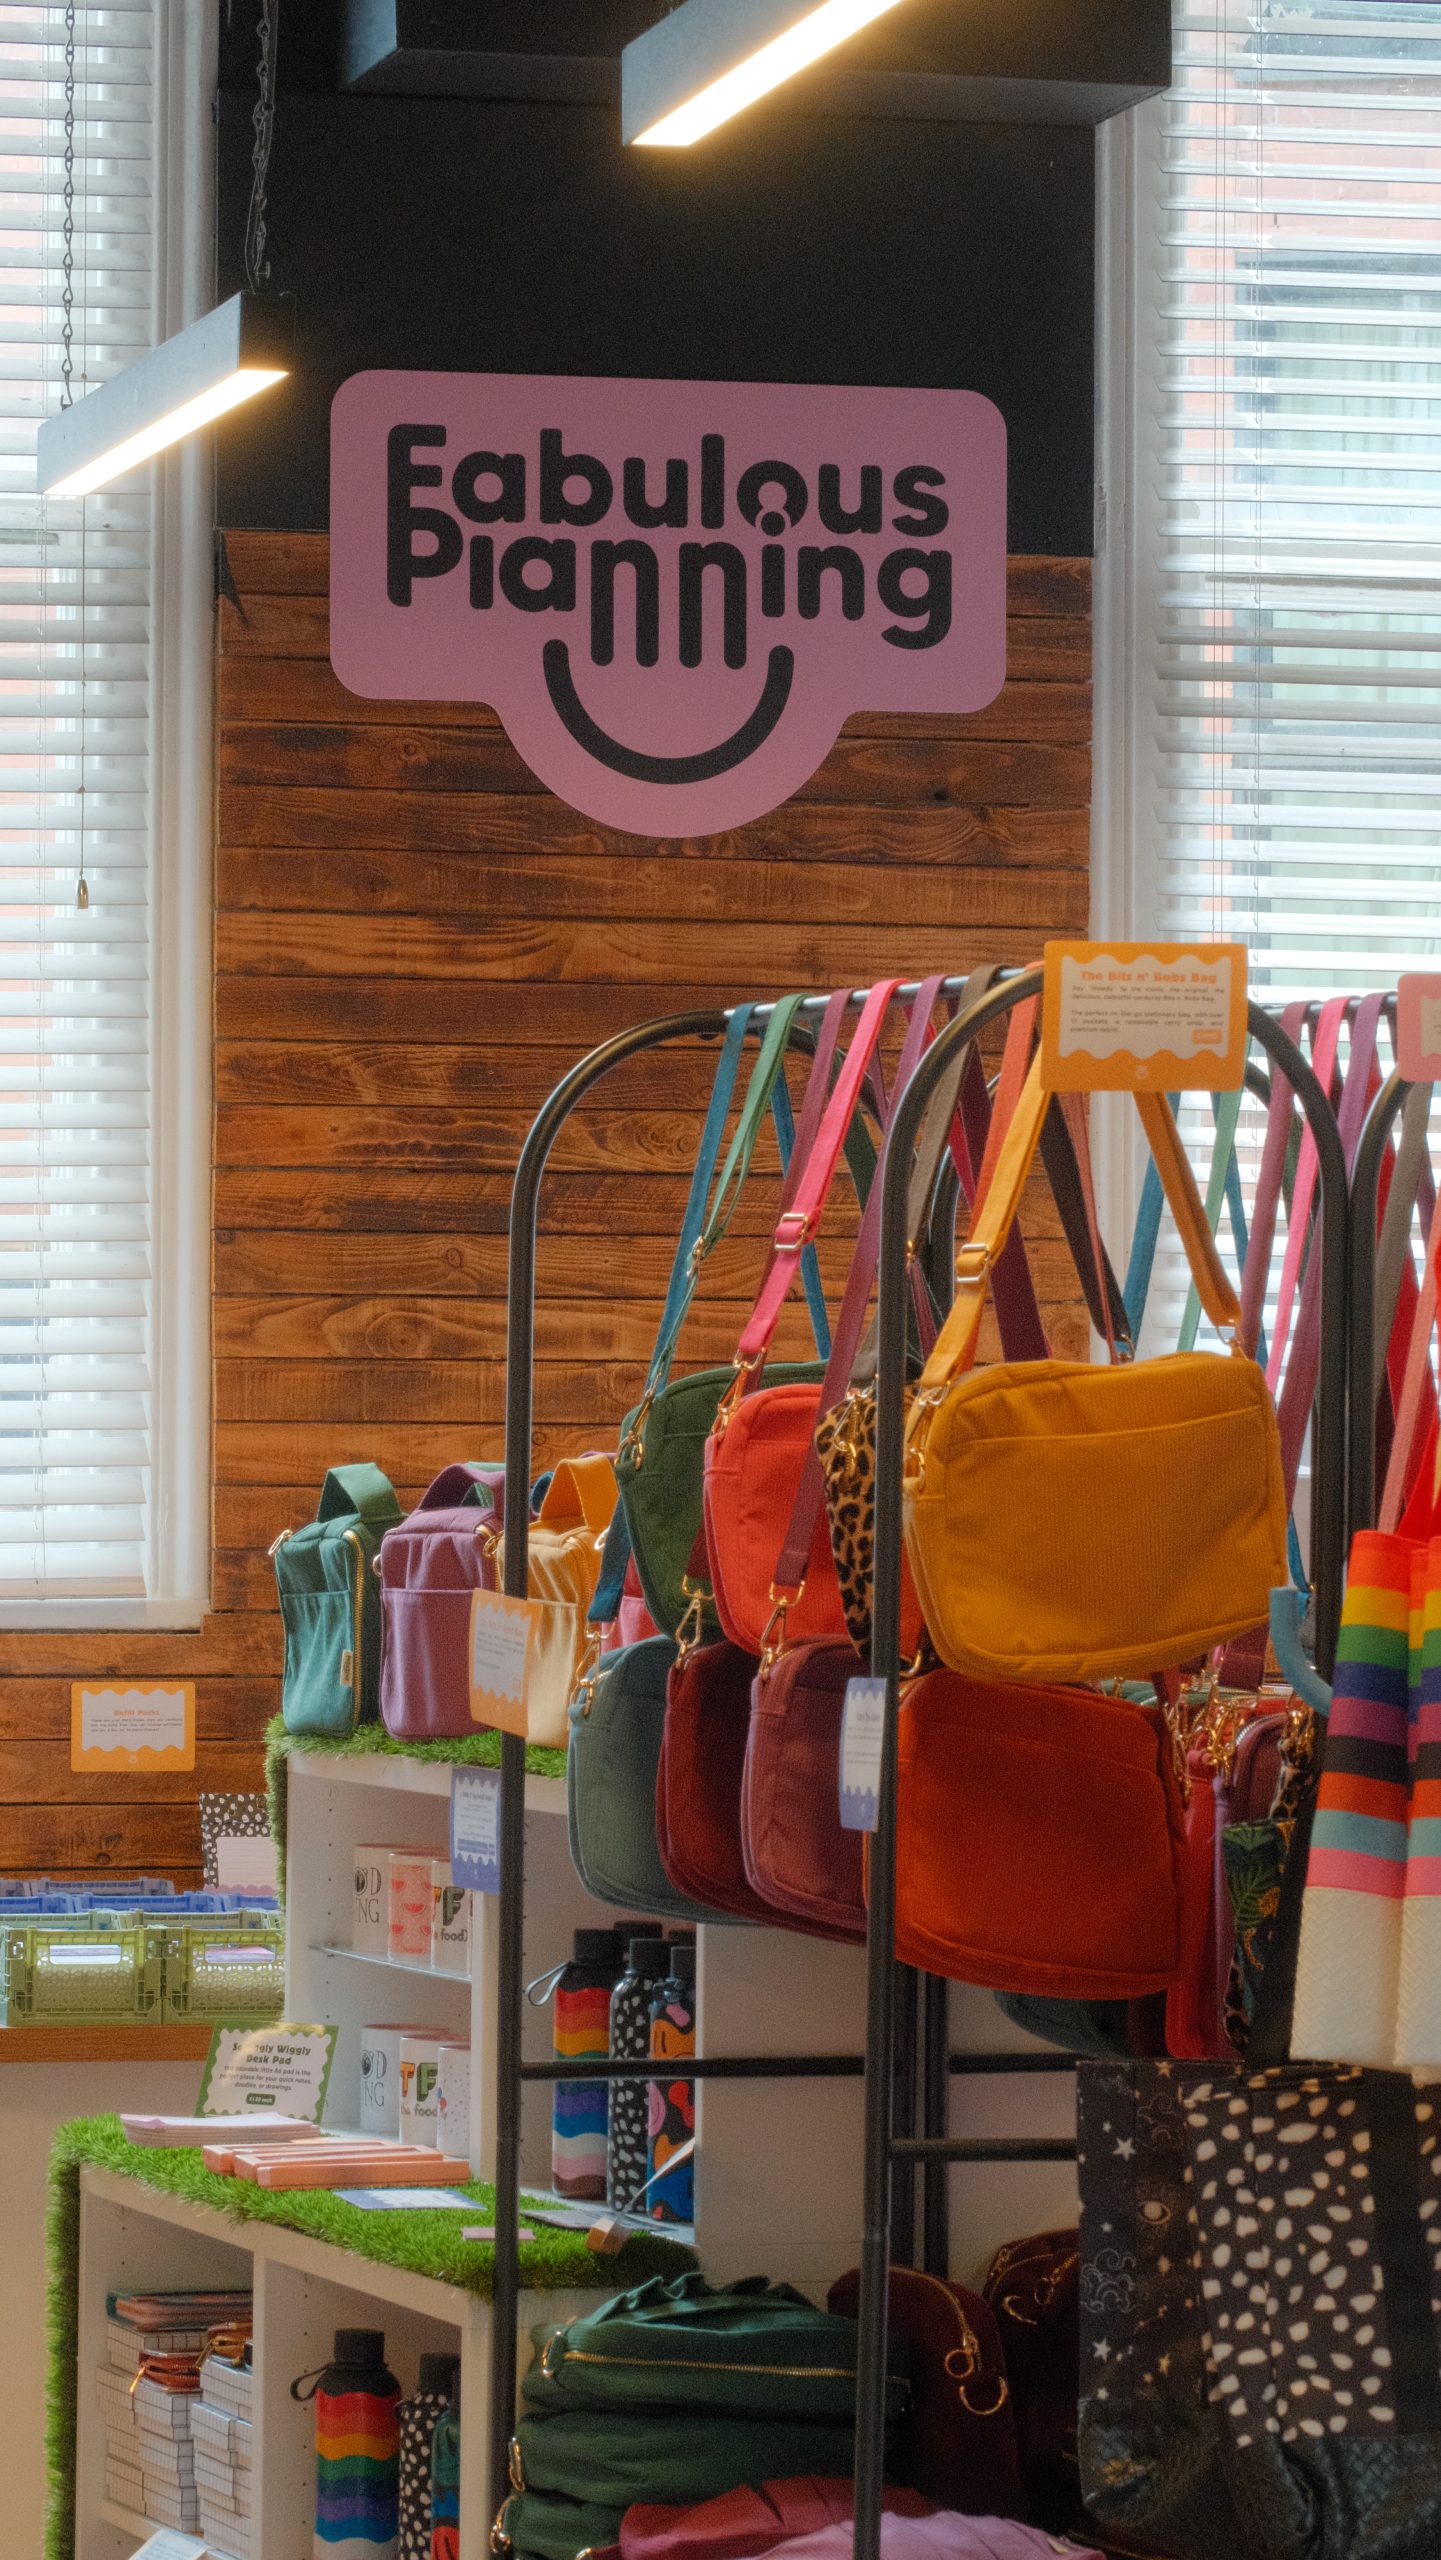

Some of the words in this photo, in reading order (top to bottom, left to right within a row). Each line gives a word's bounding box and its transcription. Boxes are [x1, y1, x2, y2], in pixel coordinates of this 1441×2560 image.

[387, 424, 949, 537] Fabulous
[387, 506, 952, 669] Planning
[1081, 971, 1104, 981] The
[1153, 972, 1185, 982] Bobs
[1191, 973, 1217, 985] Bag
[277, 2045, 312, 2056] Wiggly
[246, 2055, 269, 2063] Desk
[272, 2056, 292, 2065] Pad
